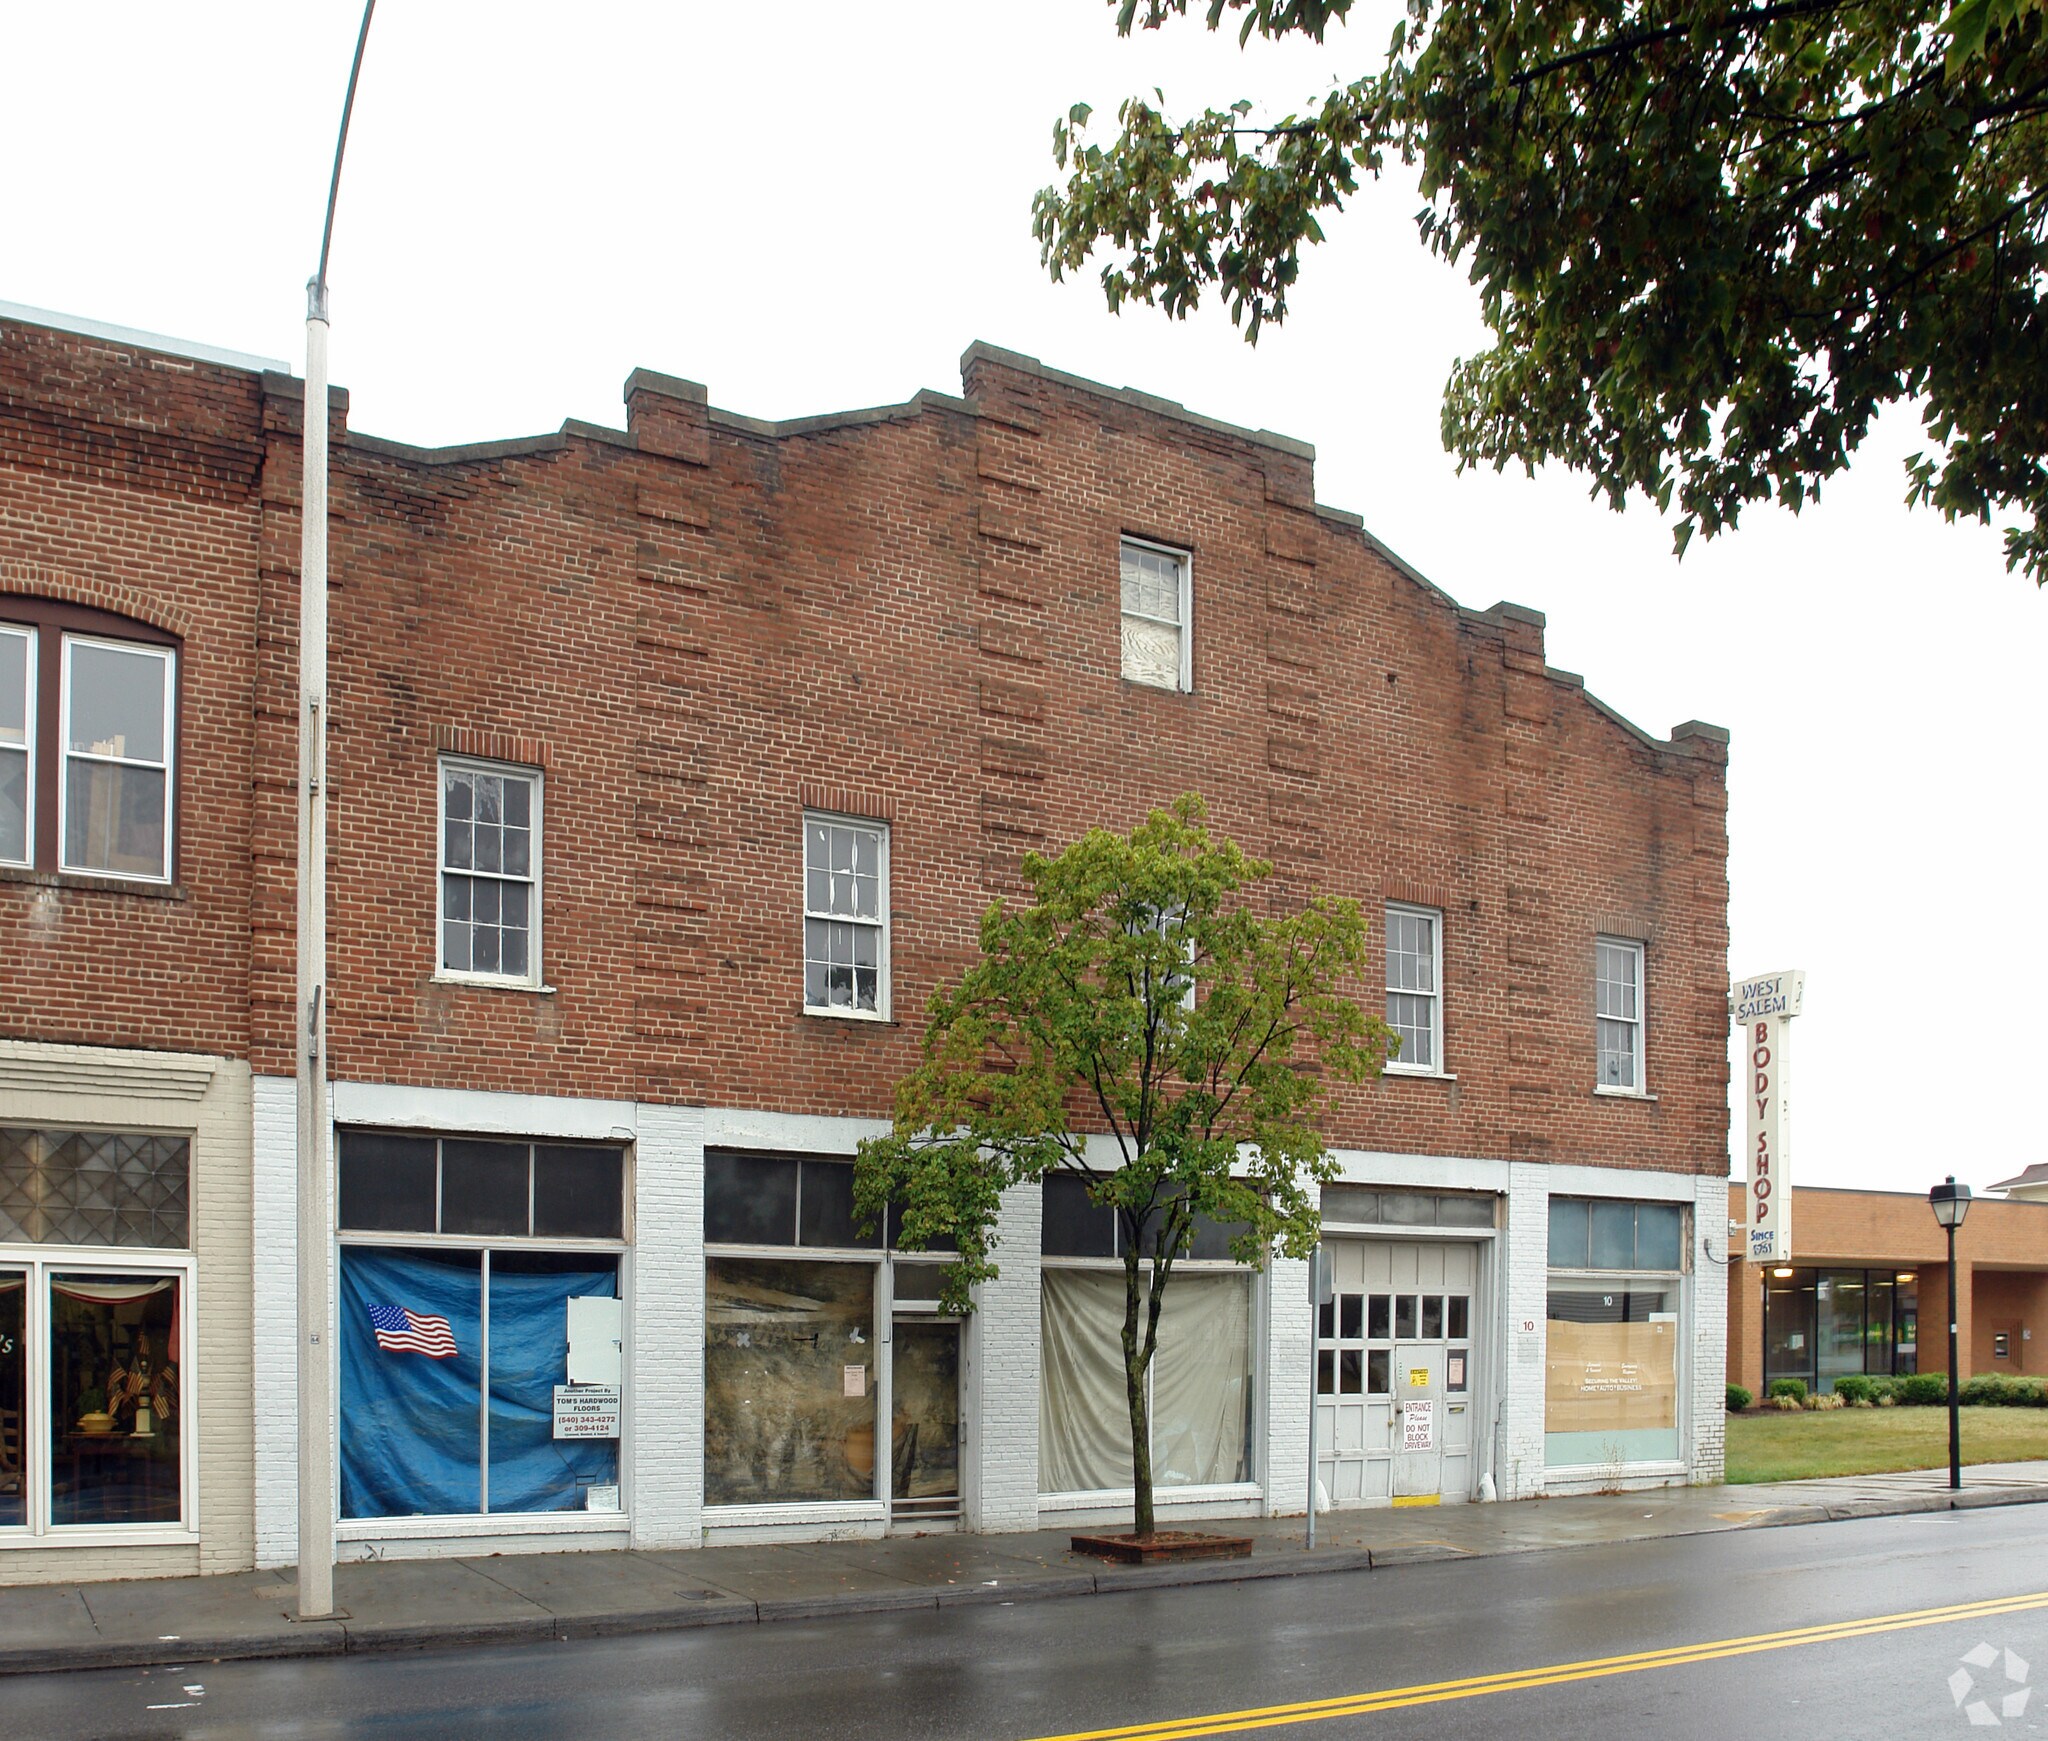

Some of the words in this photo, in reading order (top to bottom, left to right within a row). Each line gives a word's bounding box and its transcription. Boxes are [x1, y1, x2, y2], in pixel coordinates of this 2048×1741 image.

[1742, 977, 1782, 1000] WEST
[1738, 995, 1785, 1019] SALEM
[1753, 1022, 1772, 1120] BODY
[1753, 1131, 1772, 1225] SHOP
[1603, 1296, 1613, 1306] 10
[1523, 1321, 1534, 1331] 10
[1405, 1402, 1431, 1412] ENTRANCE
[1410, 1413, 1427, 1421] Please
[1418, 1424, 1430, 1432] NOT
[1408, 1433, 1428, 1441] BLOCK
[1405, 1441, 1431, 1449] DRIVEWAY
